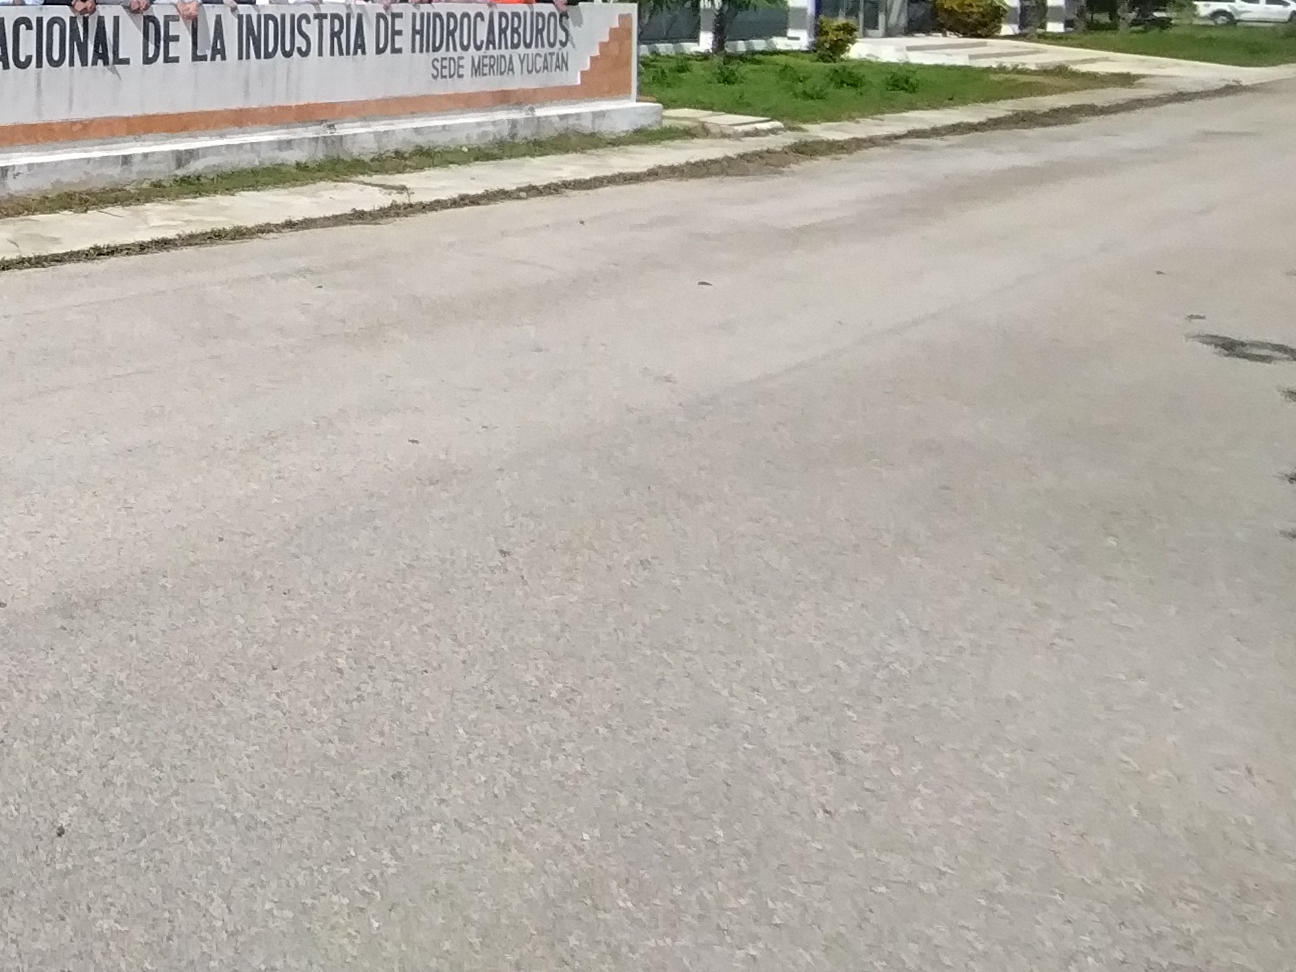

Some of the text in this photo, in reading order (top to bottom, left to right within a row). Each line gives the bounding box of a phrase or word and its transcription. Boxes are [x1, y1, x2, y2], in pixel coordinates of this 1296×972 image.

[141, 14, 180, 65] DE
[191, 13, 227, 62] LA
[237, 12, 367, 59] INDUSTRIA
[374, 12, 403, 54] DE
[411, 10, 570, 54] HIDROCARBUROS
[431, 57, 465, 79] SEDE
